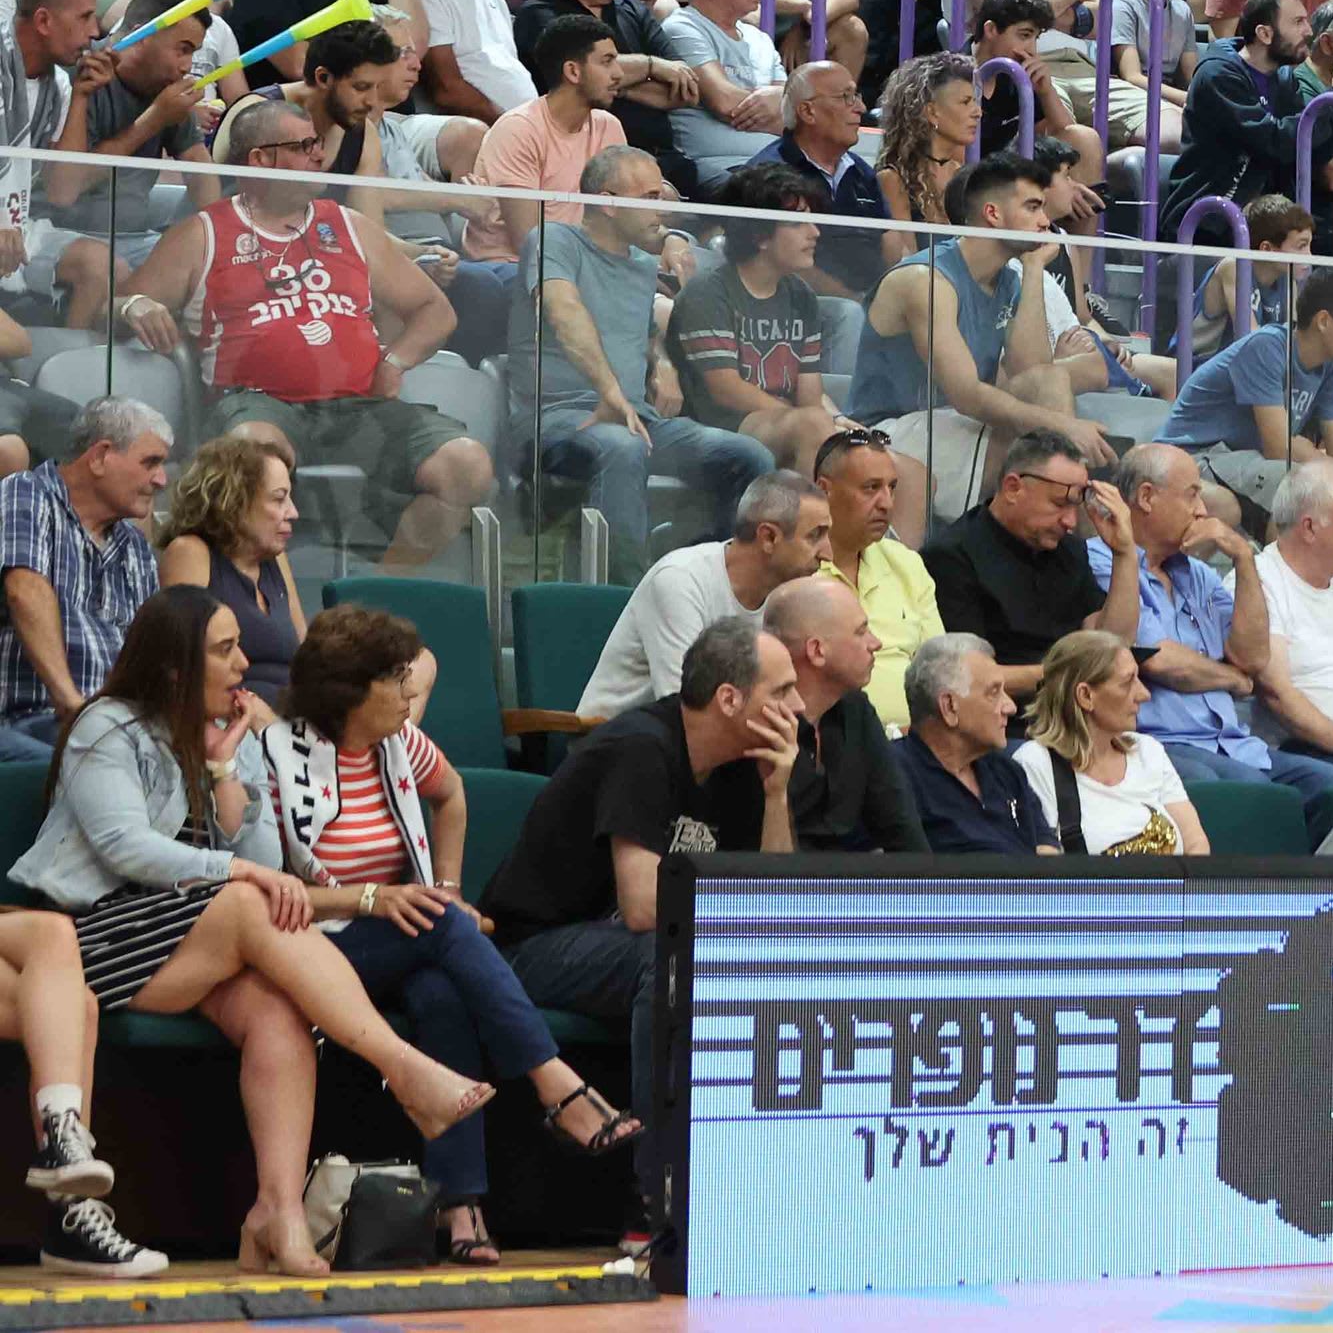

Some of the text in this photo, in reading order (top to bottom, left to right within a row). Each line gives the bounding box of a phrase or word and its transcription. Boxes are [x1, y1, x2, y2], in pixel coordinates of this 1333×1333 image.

[270, 258, 332, 297] 36
[247, 292, 358, 327] בנק יהב
